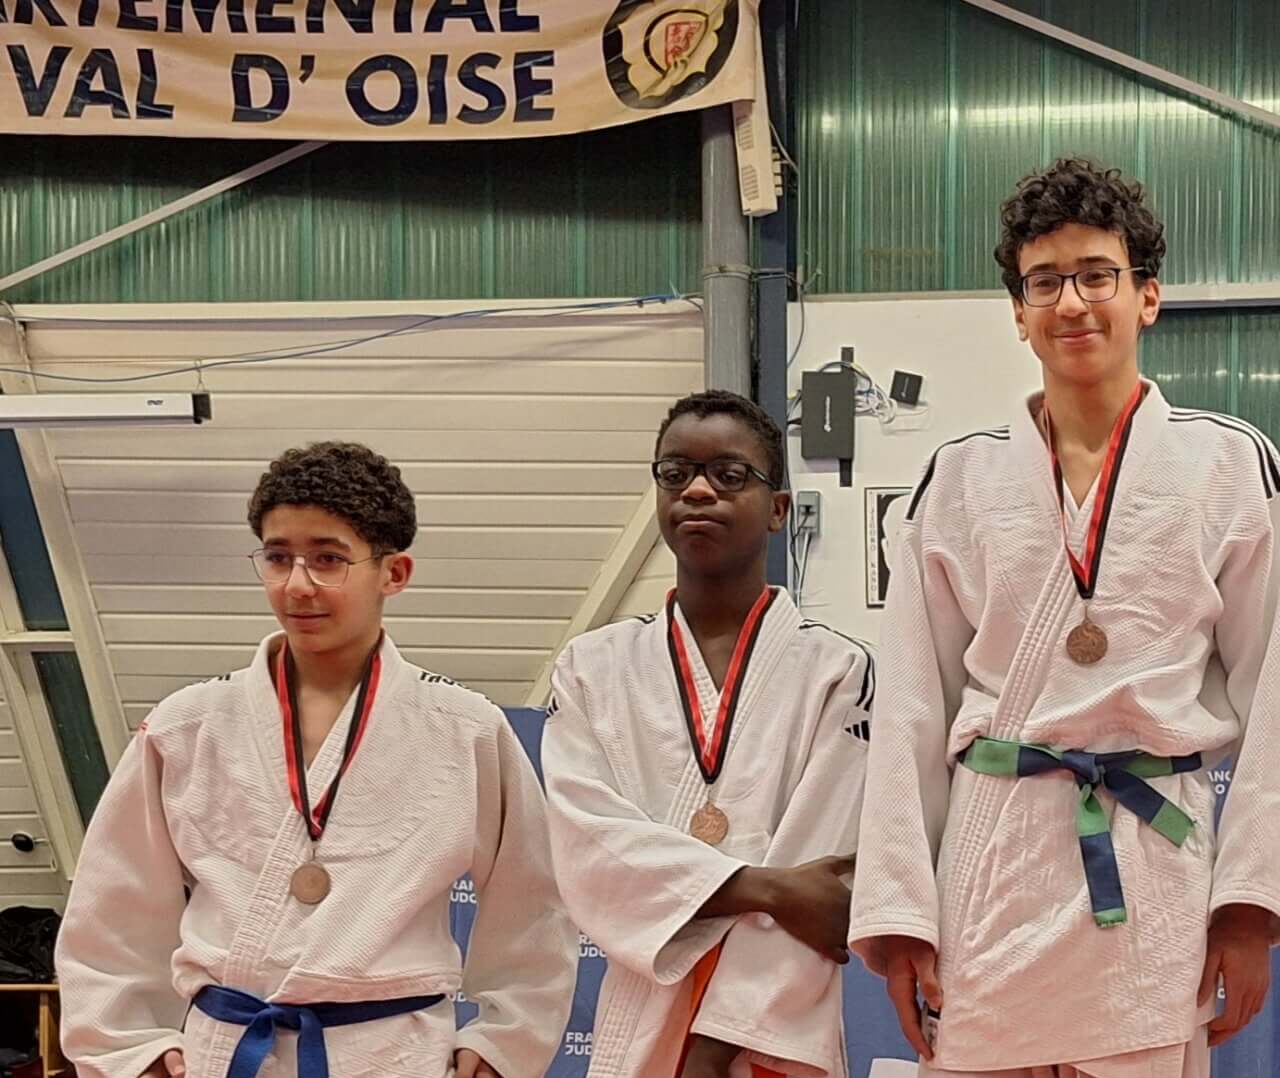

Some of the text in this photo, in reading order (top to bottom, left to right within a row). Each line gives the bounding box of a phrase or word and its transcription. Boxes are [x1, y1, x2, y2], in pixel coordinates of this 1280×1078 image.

[6, 44, 174, 119] VAL
[345, 50, 555, 126] OISE
[450, 892, 477, 904] UDO
[566, 1032, 593, 1043] FRA
[565, 1044, 593, 1055] JUD
